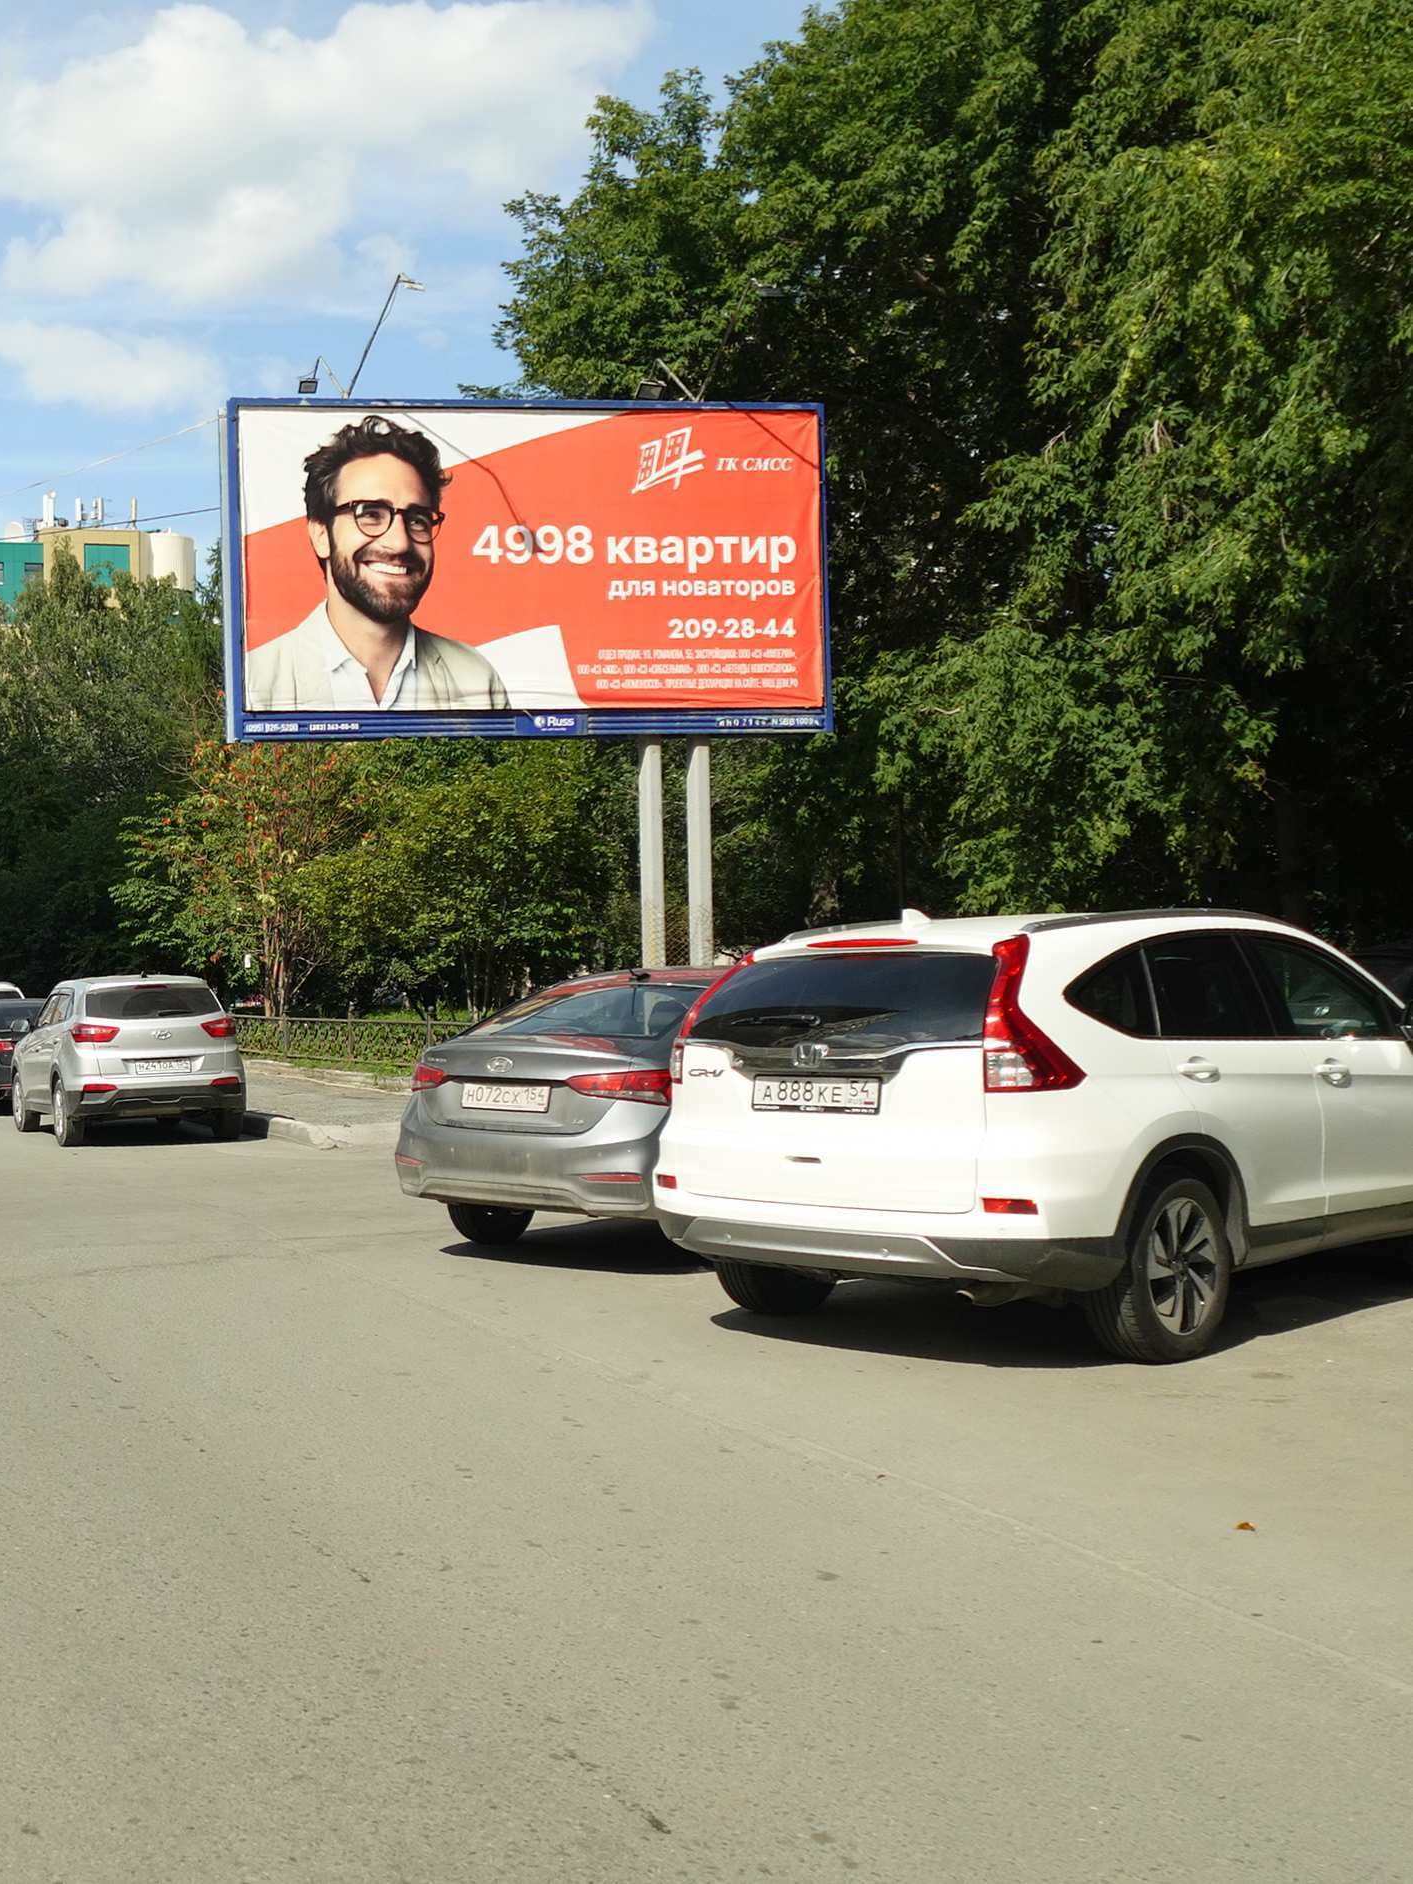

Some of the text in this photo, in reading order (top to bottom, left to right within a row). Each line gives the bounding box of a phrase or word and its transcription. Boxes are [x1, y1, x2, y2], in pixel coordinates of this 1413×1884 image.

[715, 457, 794, 472] ГК СМСС
[471, 524, 797, 573] 4998 квартир
[608, 579, 796, 601] для новаторов
[668, 618, 797, 639] 209-28-44
[547, 716, 575, 727] Russ
[524, 1087, 546, 1102] 154
[849, 1080, 870, 1098] 54
